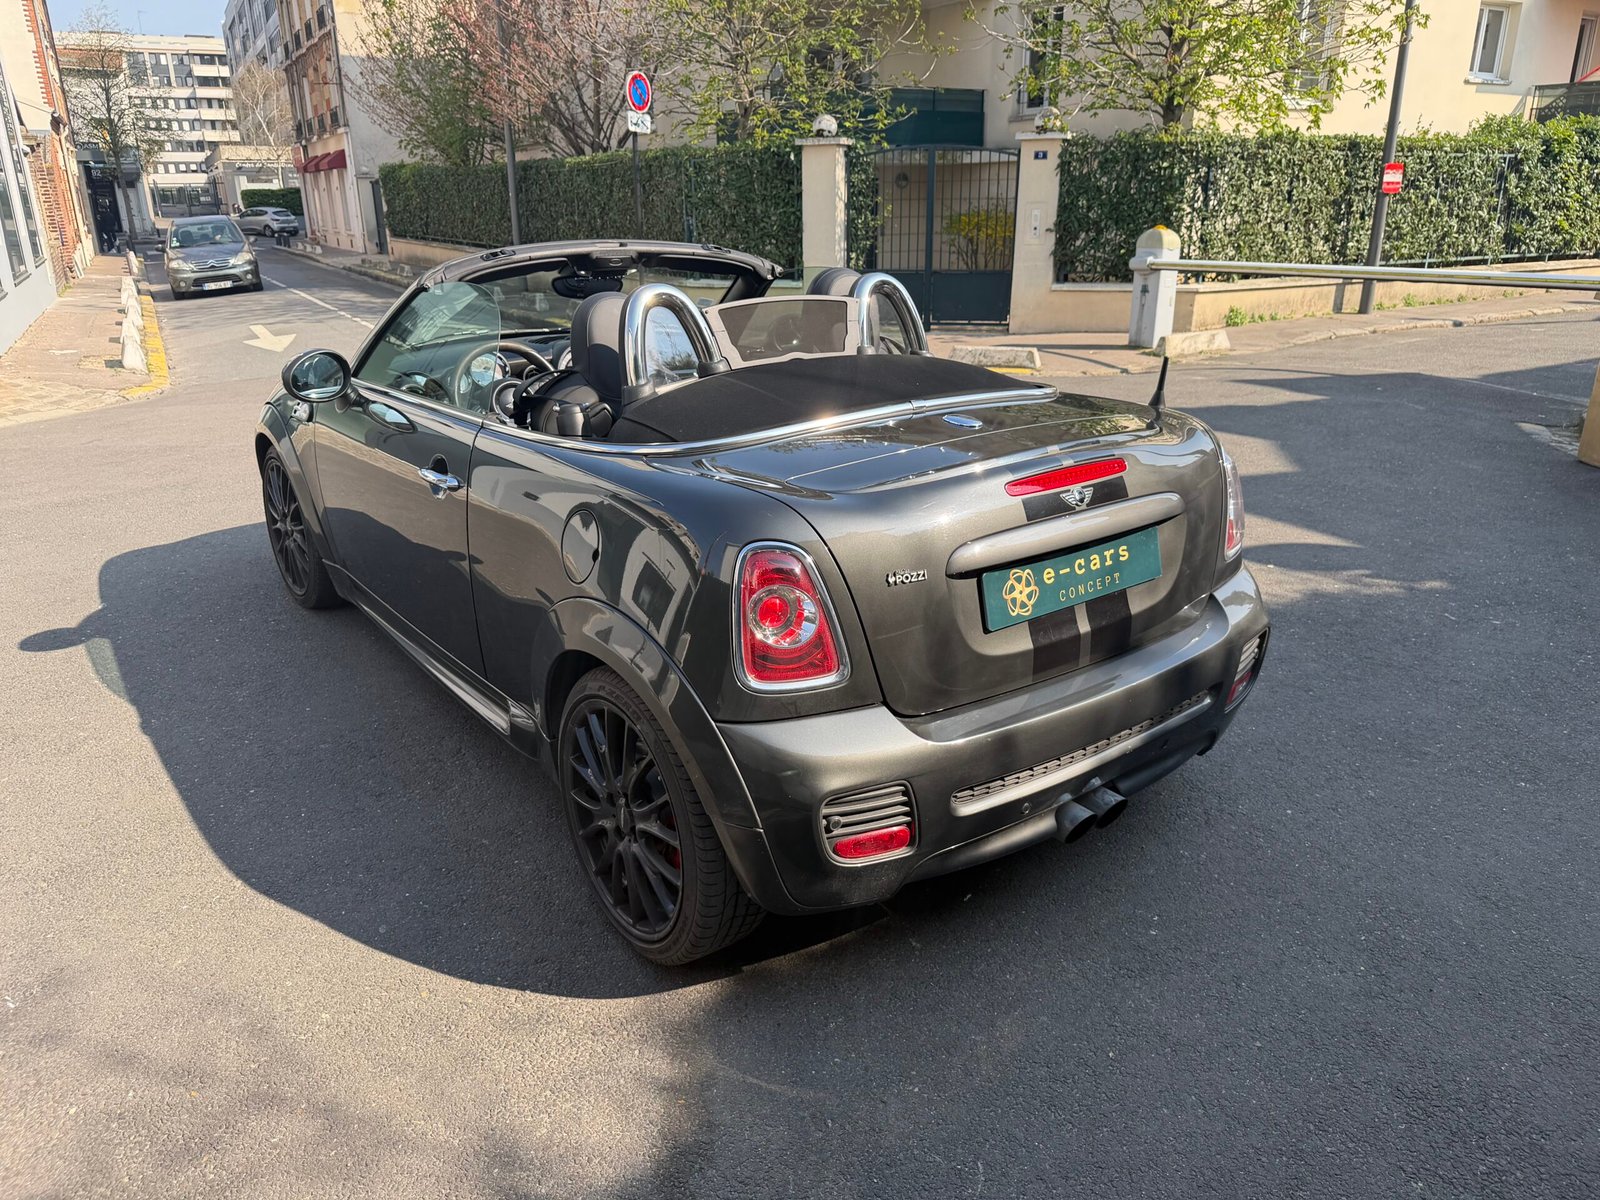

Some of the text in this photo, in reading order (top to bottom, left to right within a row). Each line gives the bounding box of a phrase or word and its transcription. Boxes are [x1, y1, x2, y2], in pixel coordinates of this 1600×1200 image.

[896, 569, 928, 584] POZZI
[1043, 544, 1130, 584] e-cars
[1059, 572, 1121, 601] CONCEPT
